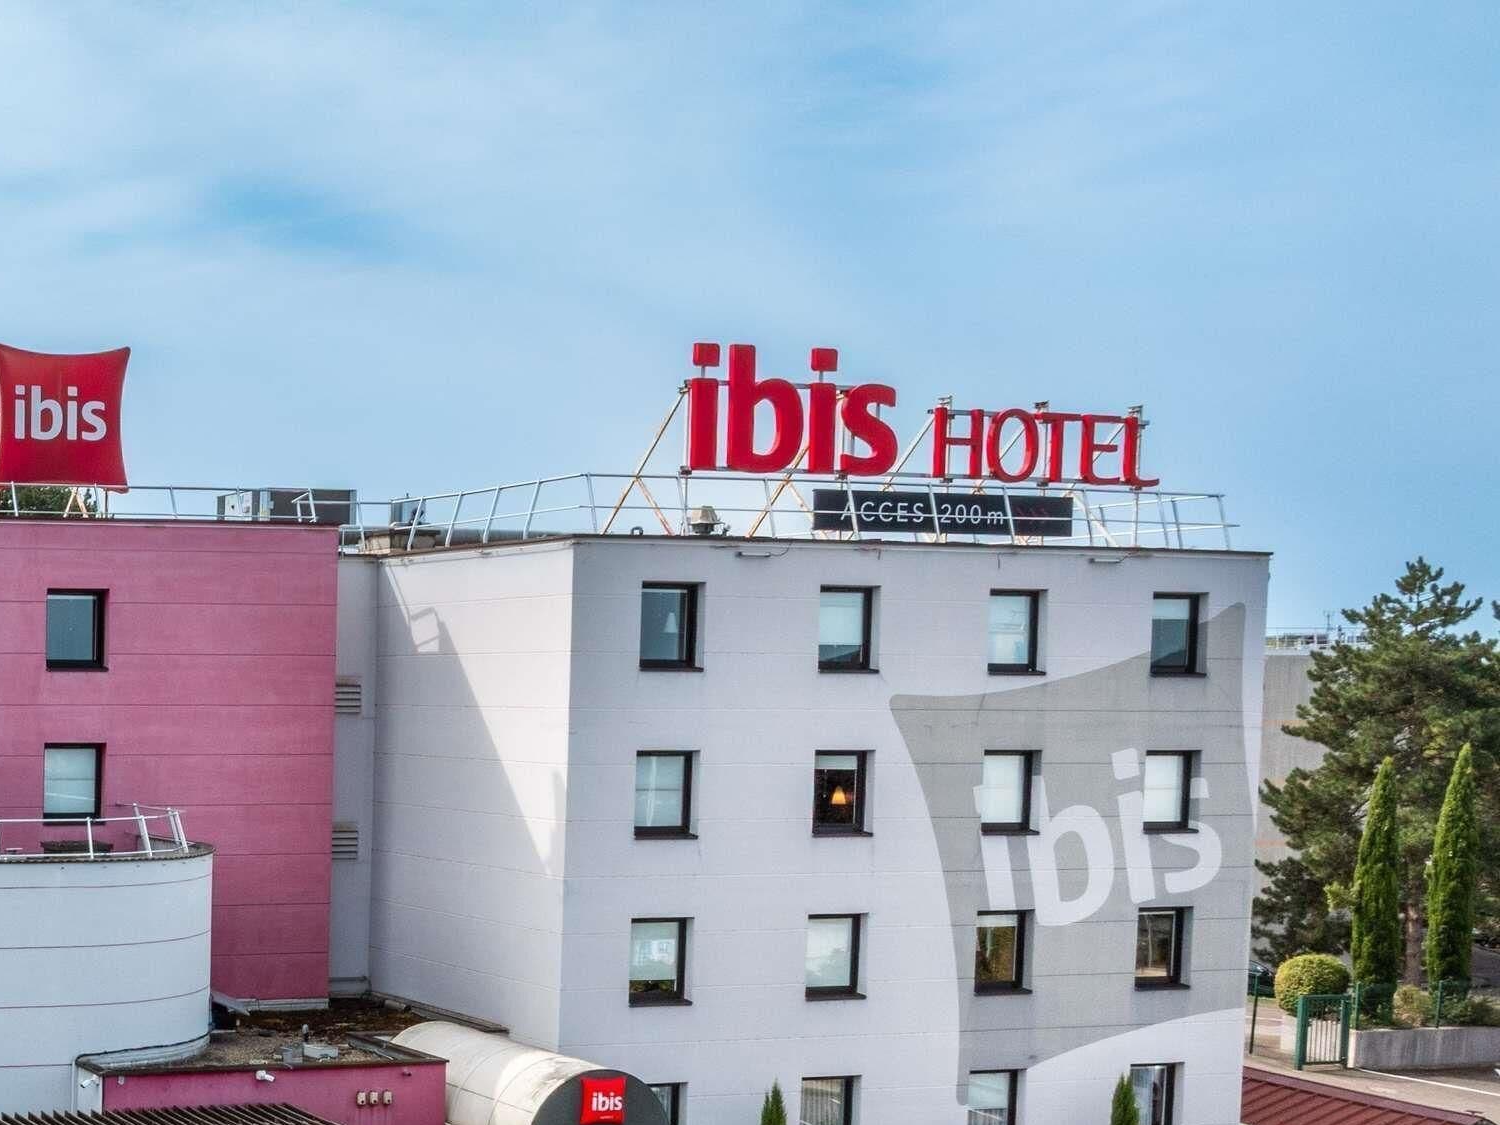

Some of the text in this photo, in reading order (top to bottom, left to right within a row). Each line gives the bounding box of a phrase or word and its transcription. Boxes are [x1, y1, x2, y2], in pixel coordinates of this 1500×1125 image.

[14, 384, 107, 442] ibis
[688, 342, 1160, 488] ibis HOTEL
[840, 501, 925, 524] ACCES
[973, 747, 1223, 927] ibis
[591, 1091, 623, 1112] ibis
